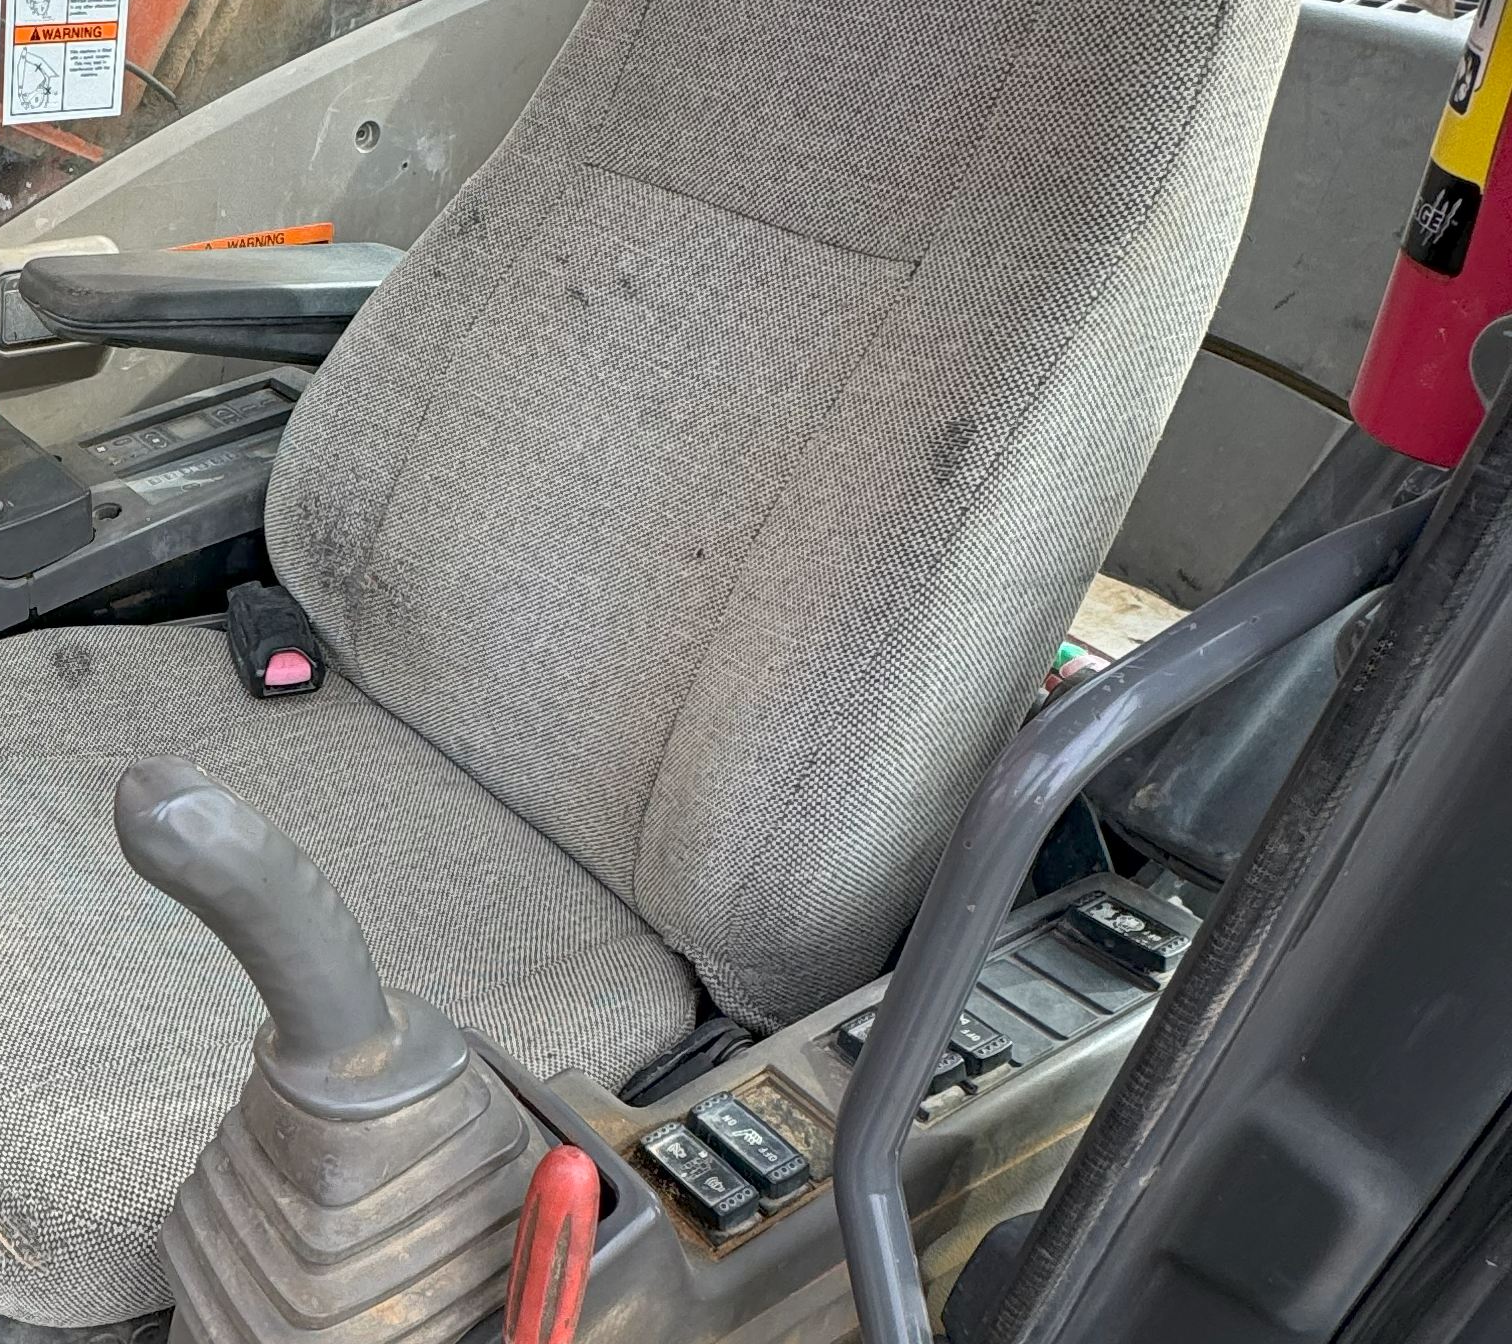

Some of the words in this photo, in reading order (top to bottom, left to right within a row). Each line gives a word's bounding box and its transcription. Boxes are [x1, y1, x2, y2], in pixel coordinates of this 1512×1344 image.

[42, 26, 103, 40] WARNING
[959, 1029, 981, 1042] OFF
[721, 1114, 738, 1127] ON
[757, 1147, 778, 1162] OFF
